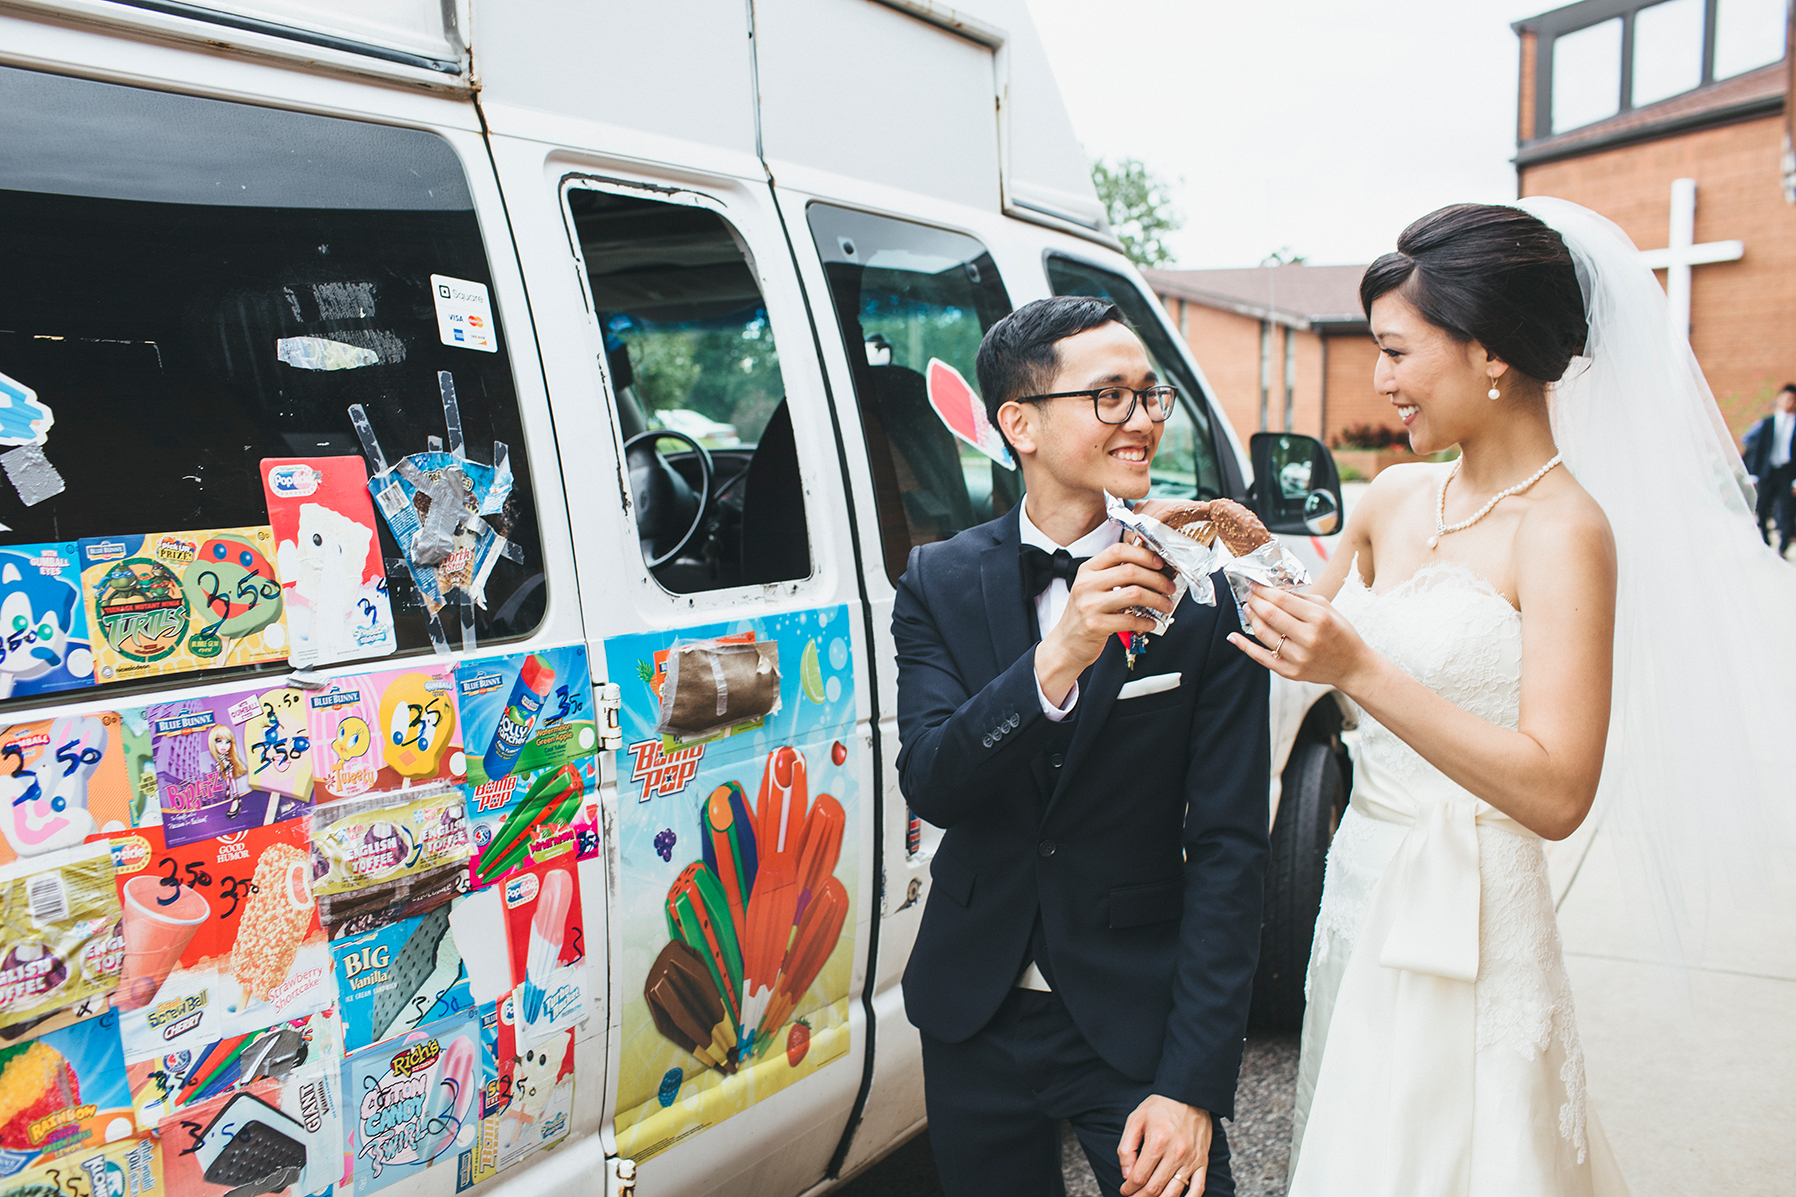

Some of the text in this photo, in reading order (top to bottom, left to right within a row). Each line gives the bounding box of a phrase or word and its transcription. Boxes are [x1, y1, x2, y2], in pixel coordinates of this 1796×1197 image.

[448, 313, 465, 323] VISA
[30, 557, 71, 568] GUMBALL
[439, 547, 473, 565] orth
[445, 561, 466, 574] Star
[39, 567, 63, 577] EYES
[102, 606, 188, 652] TURTLES
[463, 676, 502, 692] BLUE BUNNY
[230, 702, 260, 718] GUMBALL
[314, 692, 359, 707] BLUE BUNNY
[158, 719, 182, 732] BLUE
[182, 713, 214, 728] BUNNY
[535, 723, 573, 737] Watermelon
[535, 731, 574, 747] Green Apple
[628, 738, 707, 776] BOMB
[331, 763, 375, 792] Tweety
[475, 775, 518, 797] BOMB
[631, 760, 700, 804] POP
[477, 790, 513, 813] POP
[423, 818, 468, 842] ENGLISH
[426, 830, 469, 854] TOFFEE
[216, 850, 251, 864] HUMOR
[218, 842, 246, 855] GOOD
[351, 851, 396, 874] TOFFEE
[343, 945, 391, 979] BIG
[267, 966, 323, 1005] Strawberry
[350, 970, 389, 992] Vanilla
[274, 976, 320, 1014] Shortcake
[345, 995, 354, 1003] ICE
[354, 989, 372, 1001] CREAM
[163, 1012, 203, 1040] CHERRY
[391, 1038, 441, 1078] Rich's
[299, 1082, 322, 1134] GIANT
[317, 1080, 330, 1116] Vanilla
[360, 1073, 428, 1121] COTTON
[28, 1104, 98, 1145] RAINBOW
[364, 1092, 427, 1138] CANDY
[41, 1129, 92, 1155] GREEN APPLE
[54, 1143, 82, 1159] LEMON
[358, 1118, 429, 1179] TWIRL
[124, 1148, 141, 1173] you
[139, 1137, 157, 1193] what would
